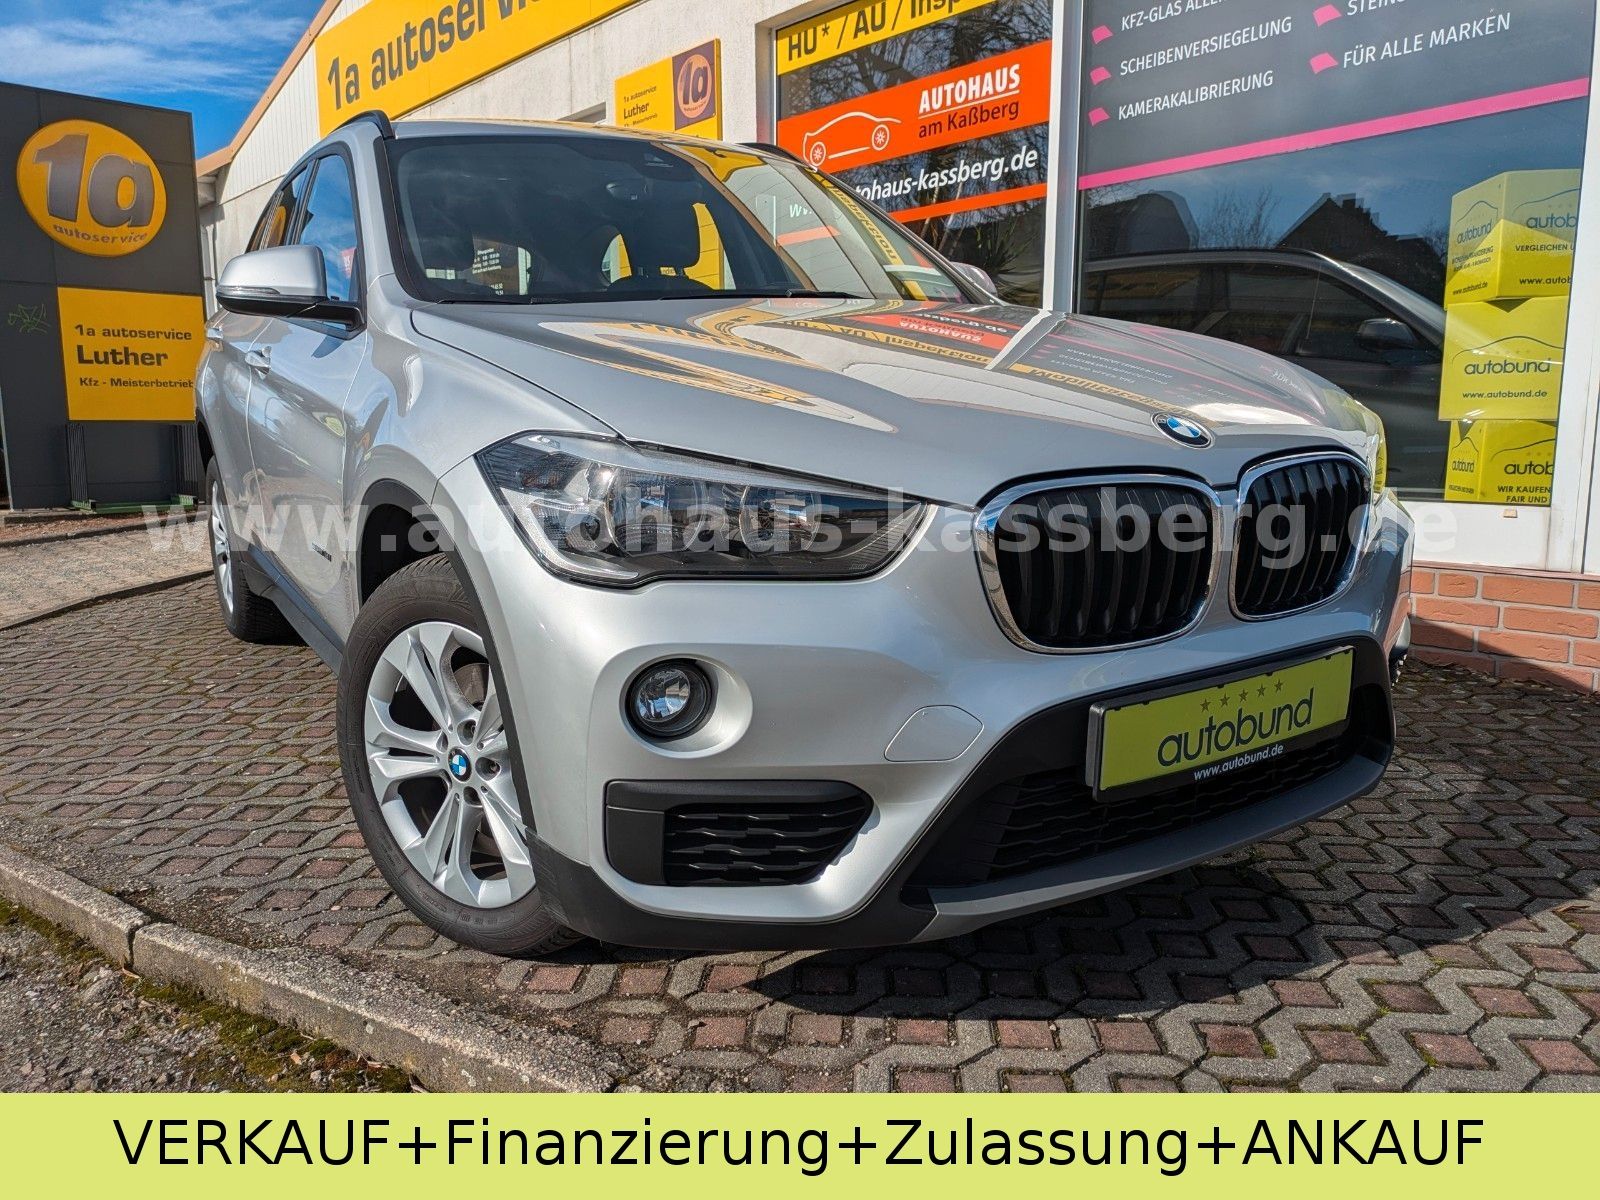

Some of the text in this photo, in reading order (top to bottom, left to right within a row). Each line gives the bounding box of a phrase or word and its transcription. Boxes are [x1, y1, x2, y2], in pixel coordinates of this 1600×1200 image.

[853, 0, 886, 40] AU
[910, 0, 961, 19] Ins
[1121, 0, 1226, 32] KFZ-GLAS ALL
[1347, 0, 1405, 16] STE
[1119, 16, 1293, 77] SCHEIBENVERSIEGELUNG
[1343, 12, 1511, 69] FÜR ALLE MARKEN
[326, 0, 541, 110] 1a autoser
[682, 61, 708, 105] 1a
[918, 63, 1021, 115] AUTOHAUS
[1117, 70, 1275, 122] KAMERAKALIBRIERUNG
[623, 102, 650, 119] Luther
[918, 101, 1020, 139] am Kaßberg
[33, 133, 155, 228] 1a
[53, 223, 148, 244] autoservice
[1456, 219, 1492, 244] autobund
[1515, 244, 1568, 252] VERGLEICHEN
[75, 324, 192, 341] 1a autoservice
[77, 344, 169, 367] Luther
[1464, 357, 1552, 376] autobund
[80, 377, 100, 388] Kfz
[1462, 390, 1548, 399] www.autobund.de
[1497, 485, 1551, 494] WIR KAUFEN
[1506, 495, 1526, 503] FAIR
[1157, 686, 1314, 767] autobund
[1193, 743, 1284, 781] www.autobund.de
